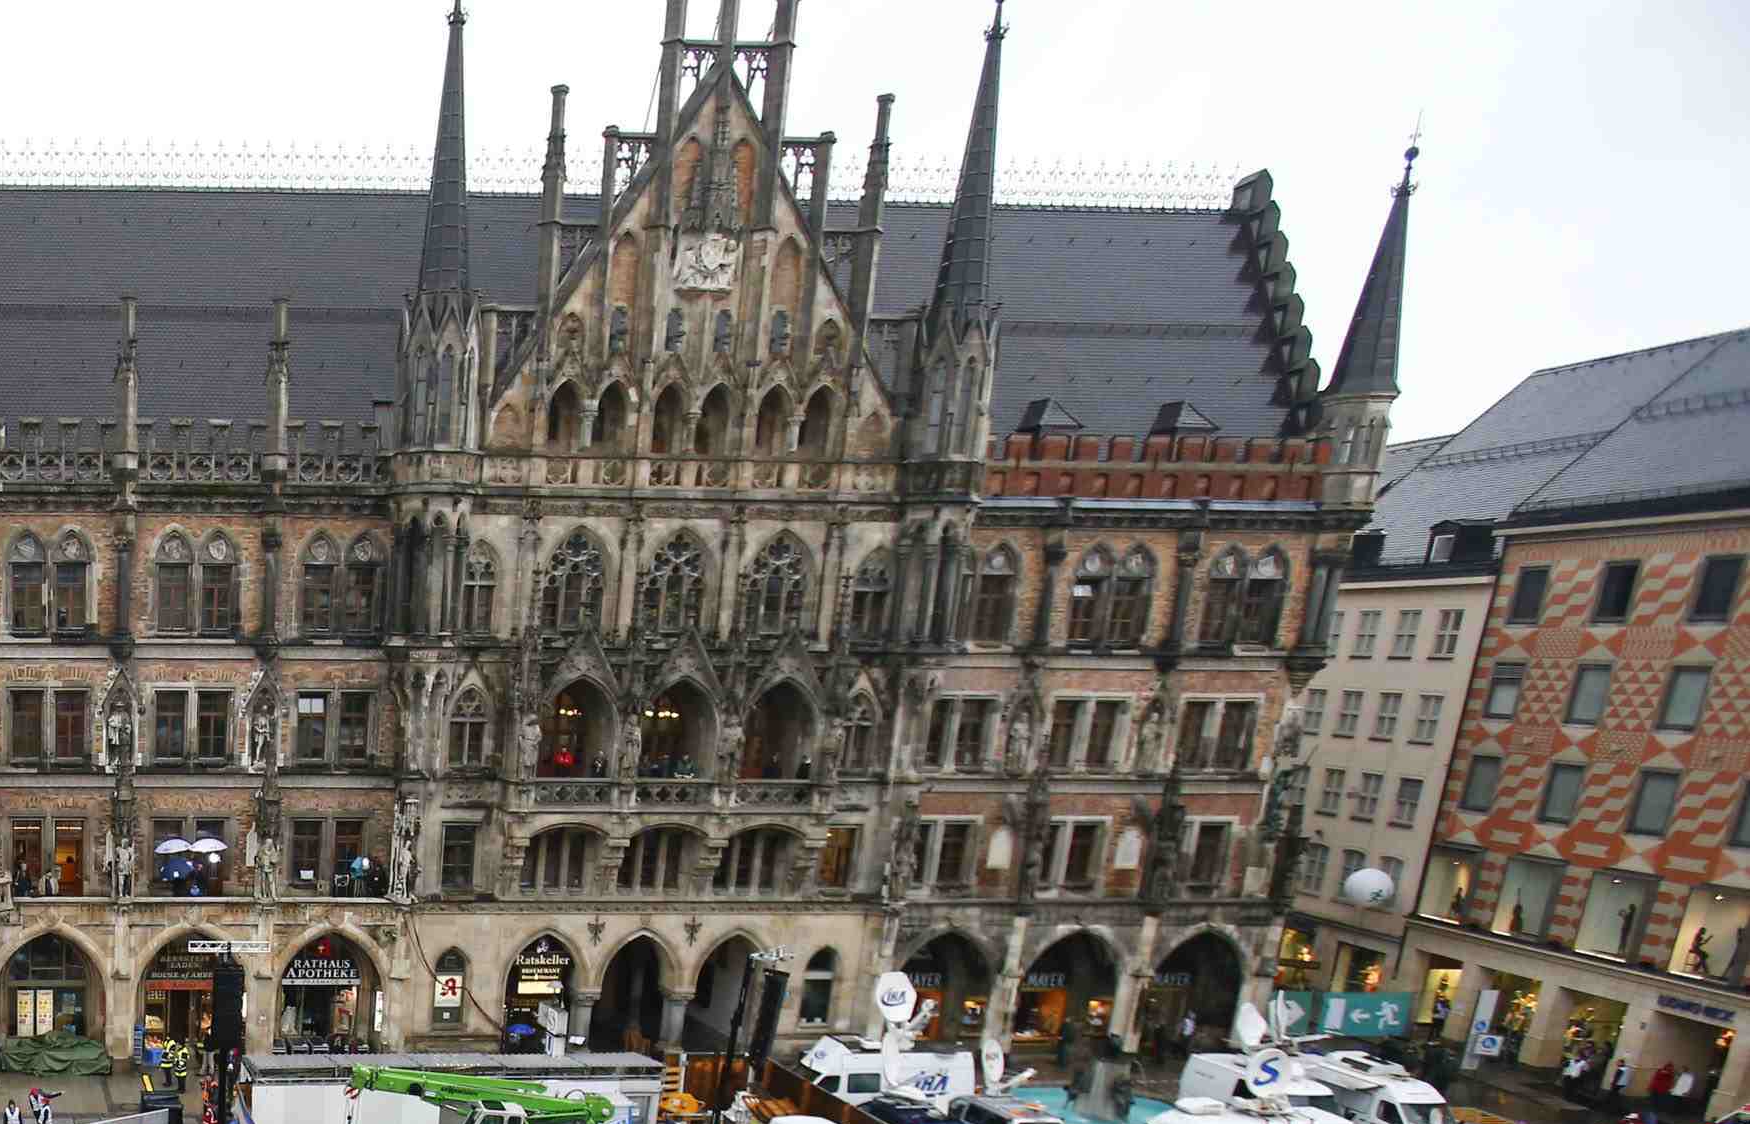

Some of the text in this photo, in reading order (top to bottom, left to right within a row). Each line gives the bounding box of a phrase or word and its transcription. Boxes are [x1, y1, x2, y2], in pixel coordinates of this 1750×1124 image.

[294, 960, 351, 969] RATHAUS
[516, 954, 570, 966] Ratskeller
[286, 968, 357, 978] APOTHEKE
